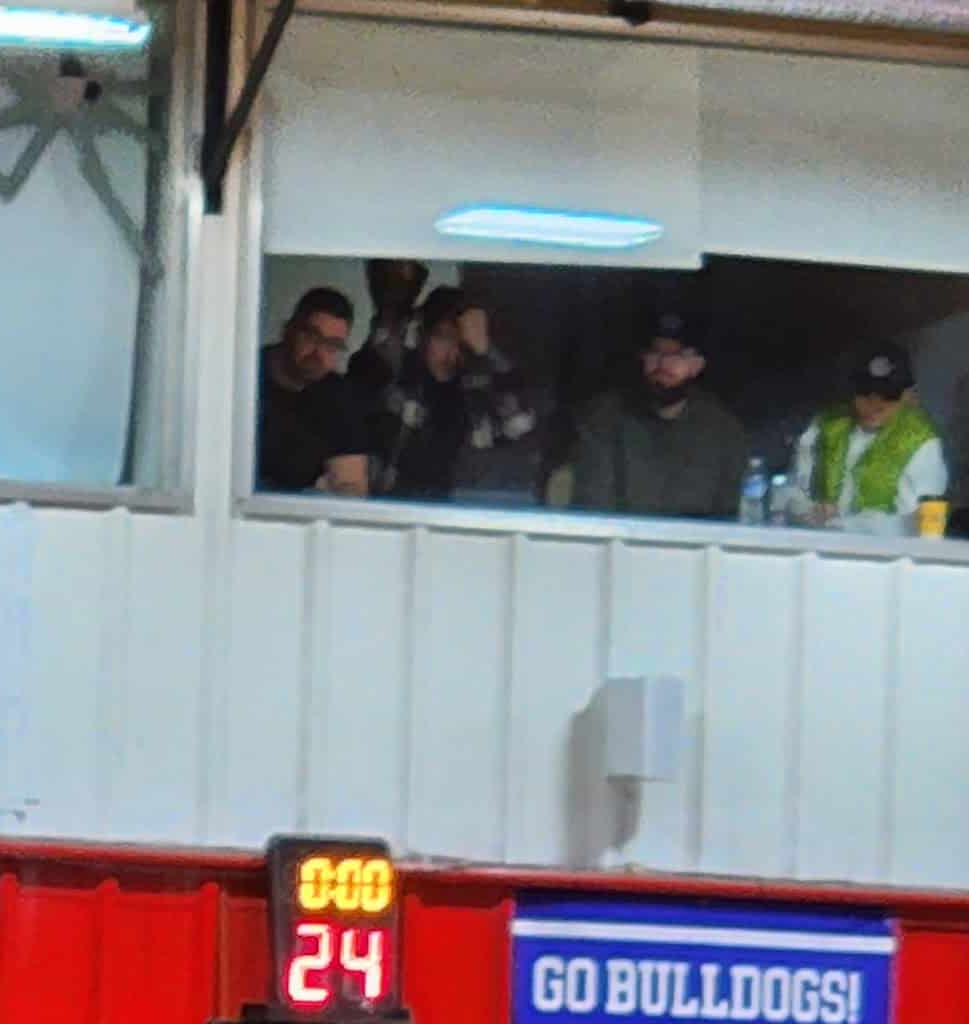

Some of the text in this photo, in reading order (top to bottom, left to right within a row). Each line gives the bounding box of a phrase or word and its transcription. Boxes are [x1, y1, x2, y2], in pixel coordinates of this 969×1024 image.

[298, 856, 393, 913] 0:00
[287, 923, 383, 1002] 24
[532, 955, 597, 1014] GO
